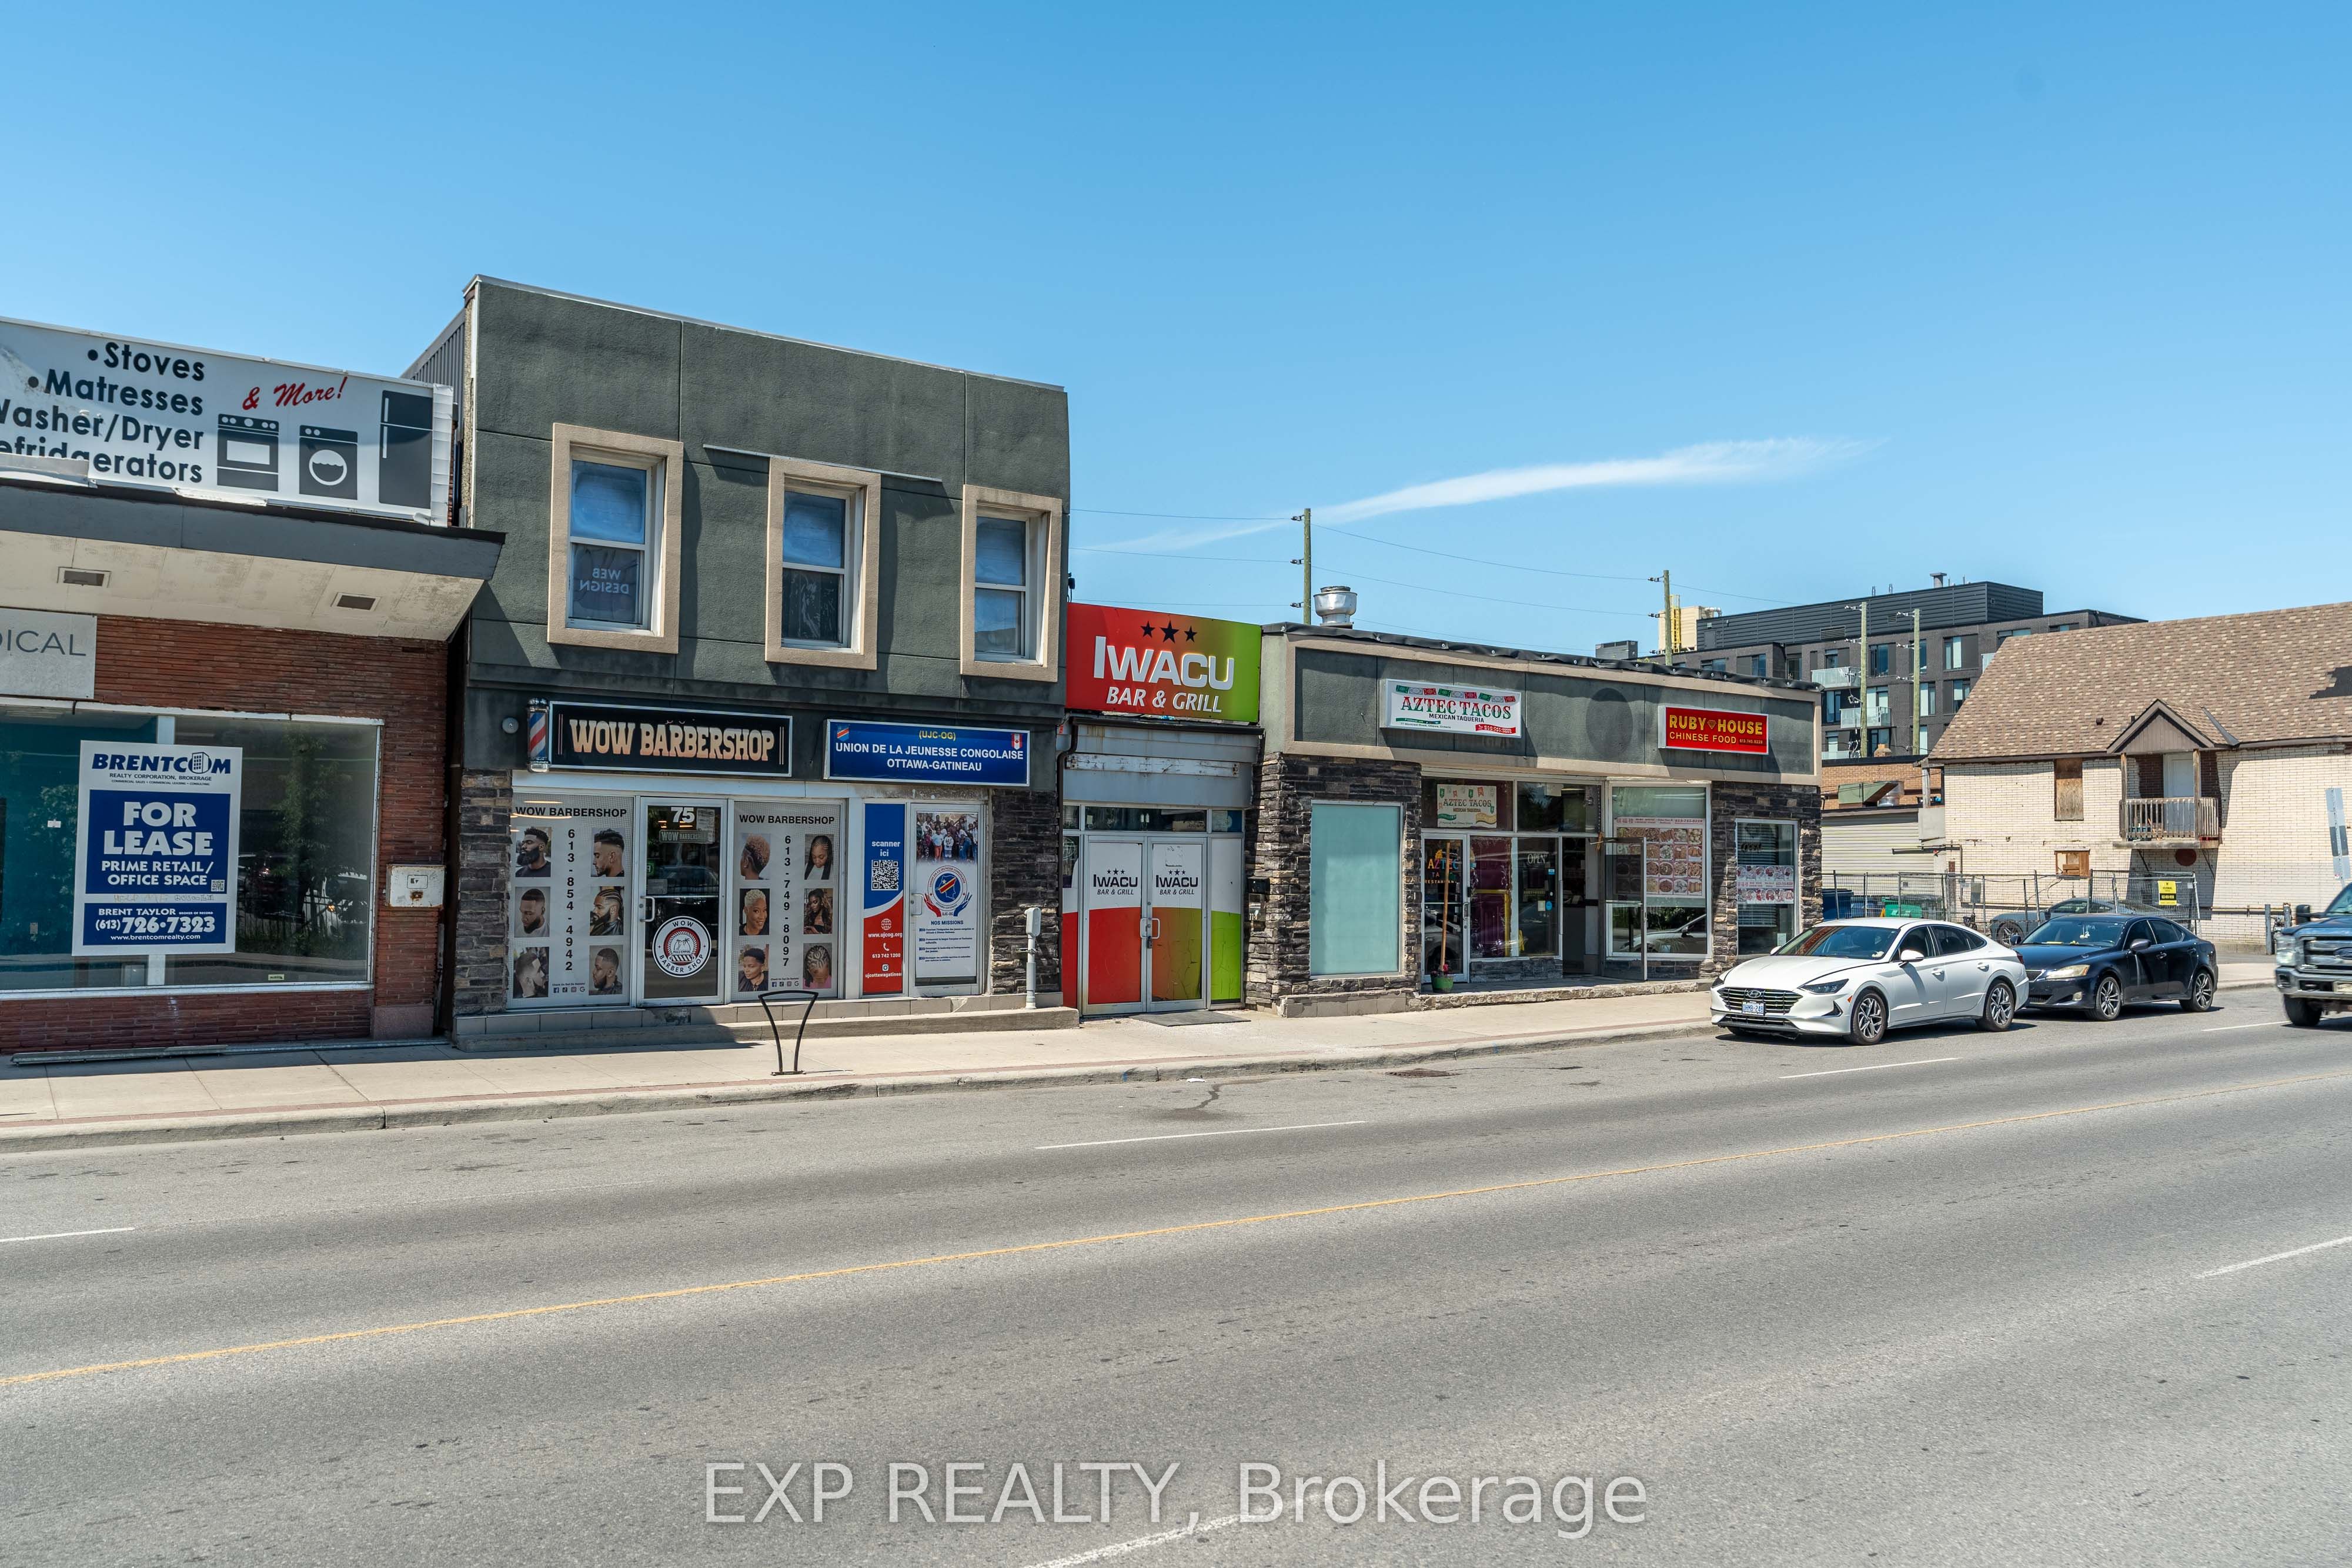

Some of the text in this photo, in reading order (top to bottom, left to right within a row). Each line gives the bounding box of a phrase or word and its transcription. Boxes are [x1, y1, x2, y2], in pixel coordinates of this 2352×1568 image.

[103, 342, 205, 382] Stoves
[45, 369, 203, 416] Matresses
[242, 376, 348, 410] & More!
[0, 629, 86, 656] ICAL
[1094, 636, 1234, 690] IWACU
[1106, 686, 1222, 713] BAR & GRILL
[1401, 696, 1511, 719] AZTEC TACOS
[1429, 713, 1455, 721] MEXICAN
[1669, 715, 1763, 735] RUBY HOUSE
[569, 719, 774, 761] WOW BARBERSHOP
[919, 730, 956, 741] (UJC-OG)
[1669, 731, 1709, 742] CHINESE
[1713, 735, 1736, 744] FOOD
[836, 743, 1024, 760] UNION DE LA JEUNESSE CONGOLAISE
[92, 752, 230, 774] BRENTCOM
[887, 758, 982, 771] OTTAWA-GATINEAU
[1444, 798, 1466, 807] AZTEC
[123, 801, 197, 827] FOR
[516, 807, 627, 817] WOW BARBERSHOP
[671, 807, 695, 823] 75
[739, 815, 834, 824] WOW BARBERSHOP
[103, 830, 213, 856] LEASE
[661, 831, 679, 841] WOW
[101, 861, 214, 874] PRIME RETAIL/
[1527, 854, 1546, 864] OPEN
[108, 875, 208, 885] OFFICE SPACE
[1093, 874, 1138, 888] IWACU
[1156, 875, 1198, 888] IWACU
[565, 829, 575, 971] 613-854-4942
[783, 835, 791, 967] 613-749-8097
[95, 920, 121, 931] (613)
[659, 954, 704, 973] BARBER SHOP
